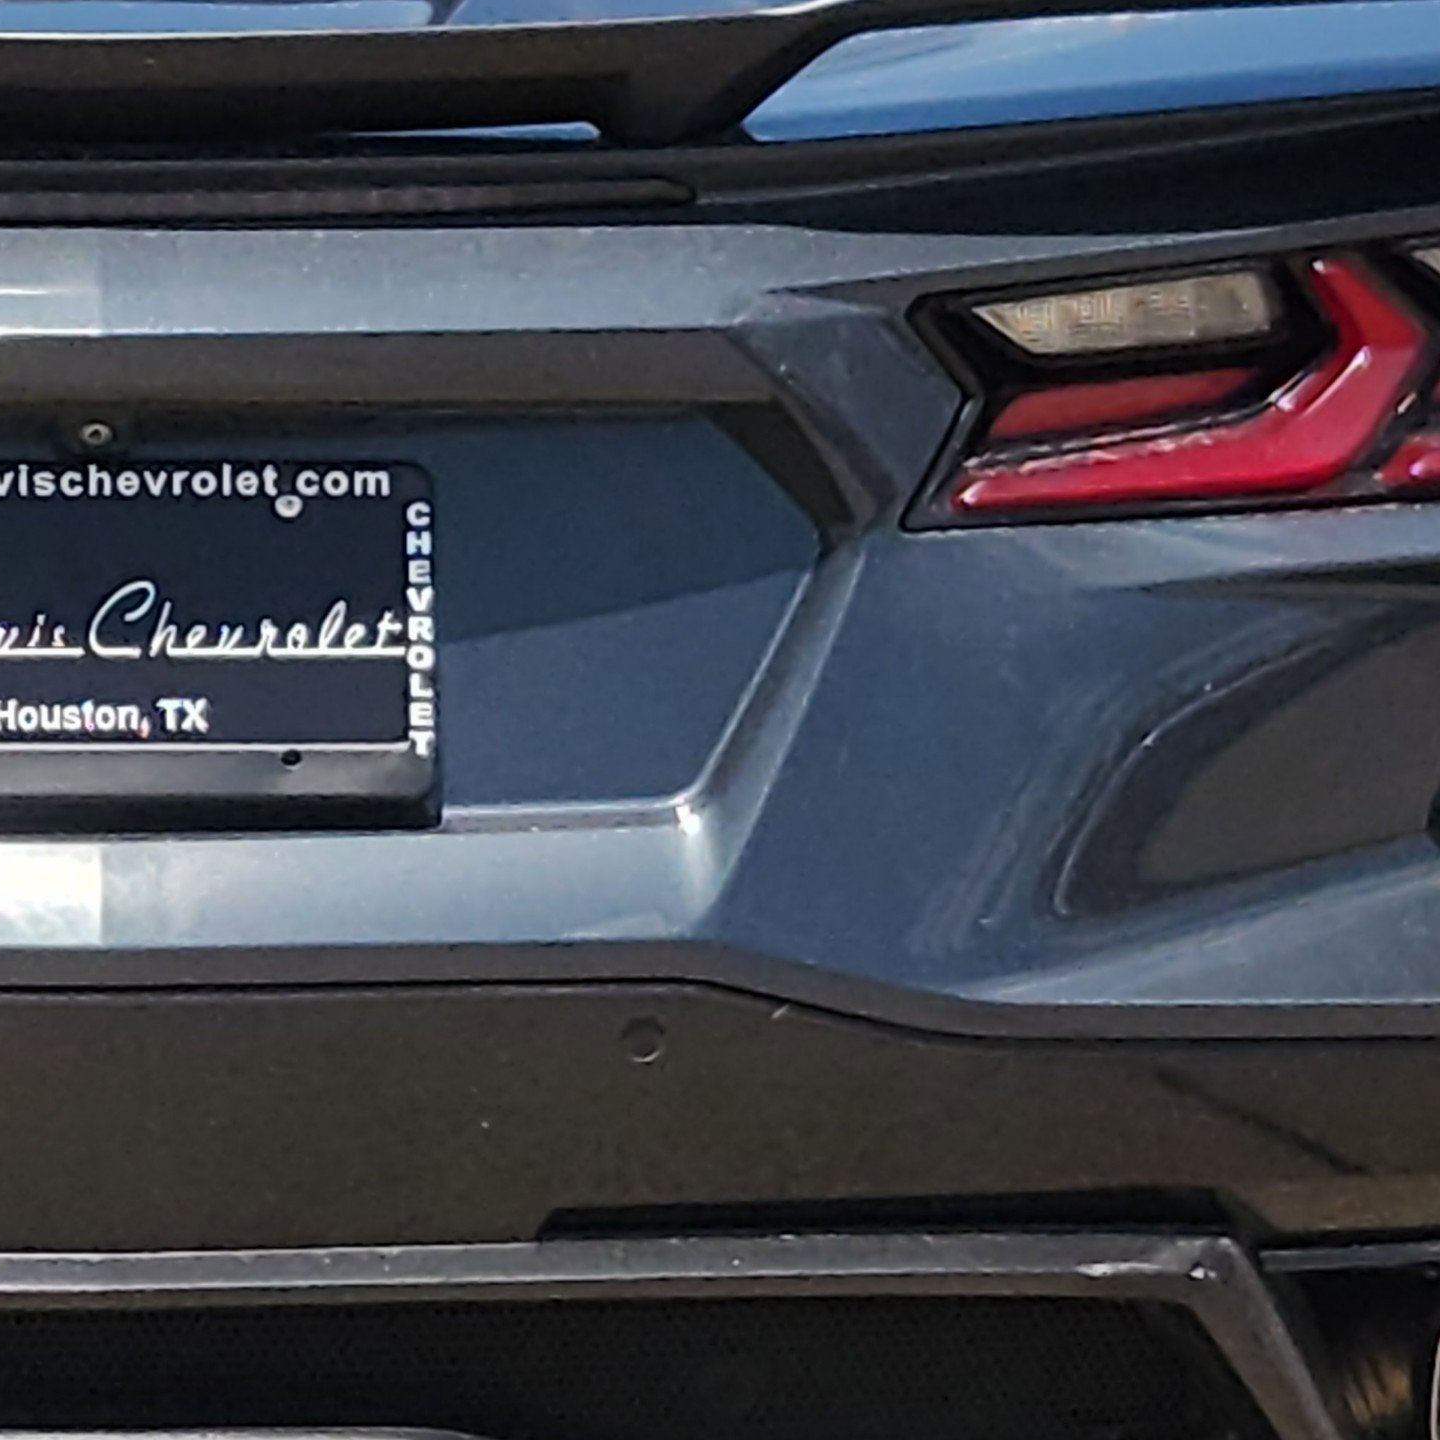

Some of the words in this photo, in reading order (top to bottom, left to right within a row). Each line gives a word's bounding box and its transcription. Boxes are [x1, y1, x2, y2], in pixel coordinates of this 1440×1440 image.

[88, 580, 408, 658] Chevrolet
[406, 502, 432, 757] CHEVROLET
[157, 698, 209, 732] TX
